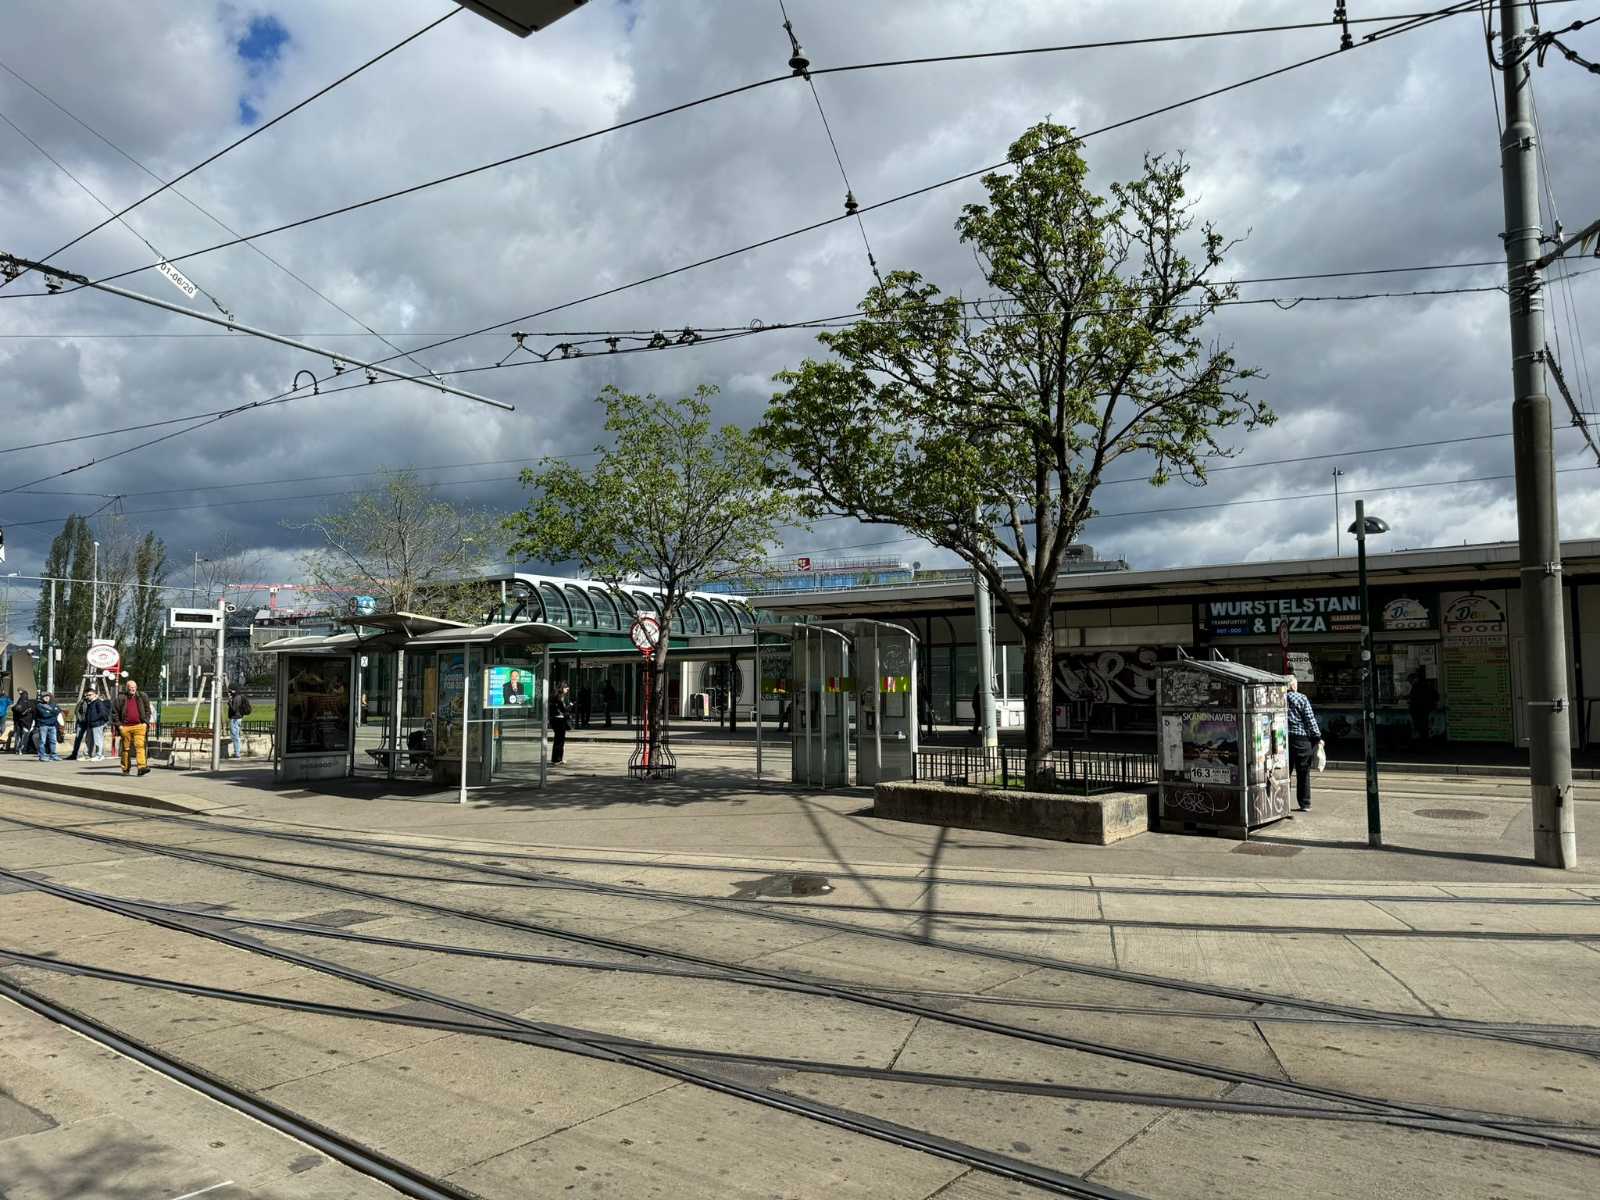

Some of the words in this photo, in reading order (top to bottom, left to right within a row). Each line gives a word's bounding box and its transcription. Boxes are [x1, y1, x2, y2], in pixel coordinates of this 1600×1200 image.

[160, 262, 194, 294] 01-06/20
[1210, 597, 1361, 616] WURSTELSTAN
[1253, 618, 1266, 633] &
[1271, 616, 1327, 632] PZZA
[1447, 623, 1502, 633] Food
[1182, 711, 1237, 722] SKANDINAVIEN
